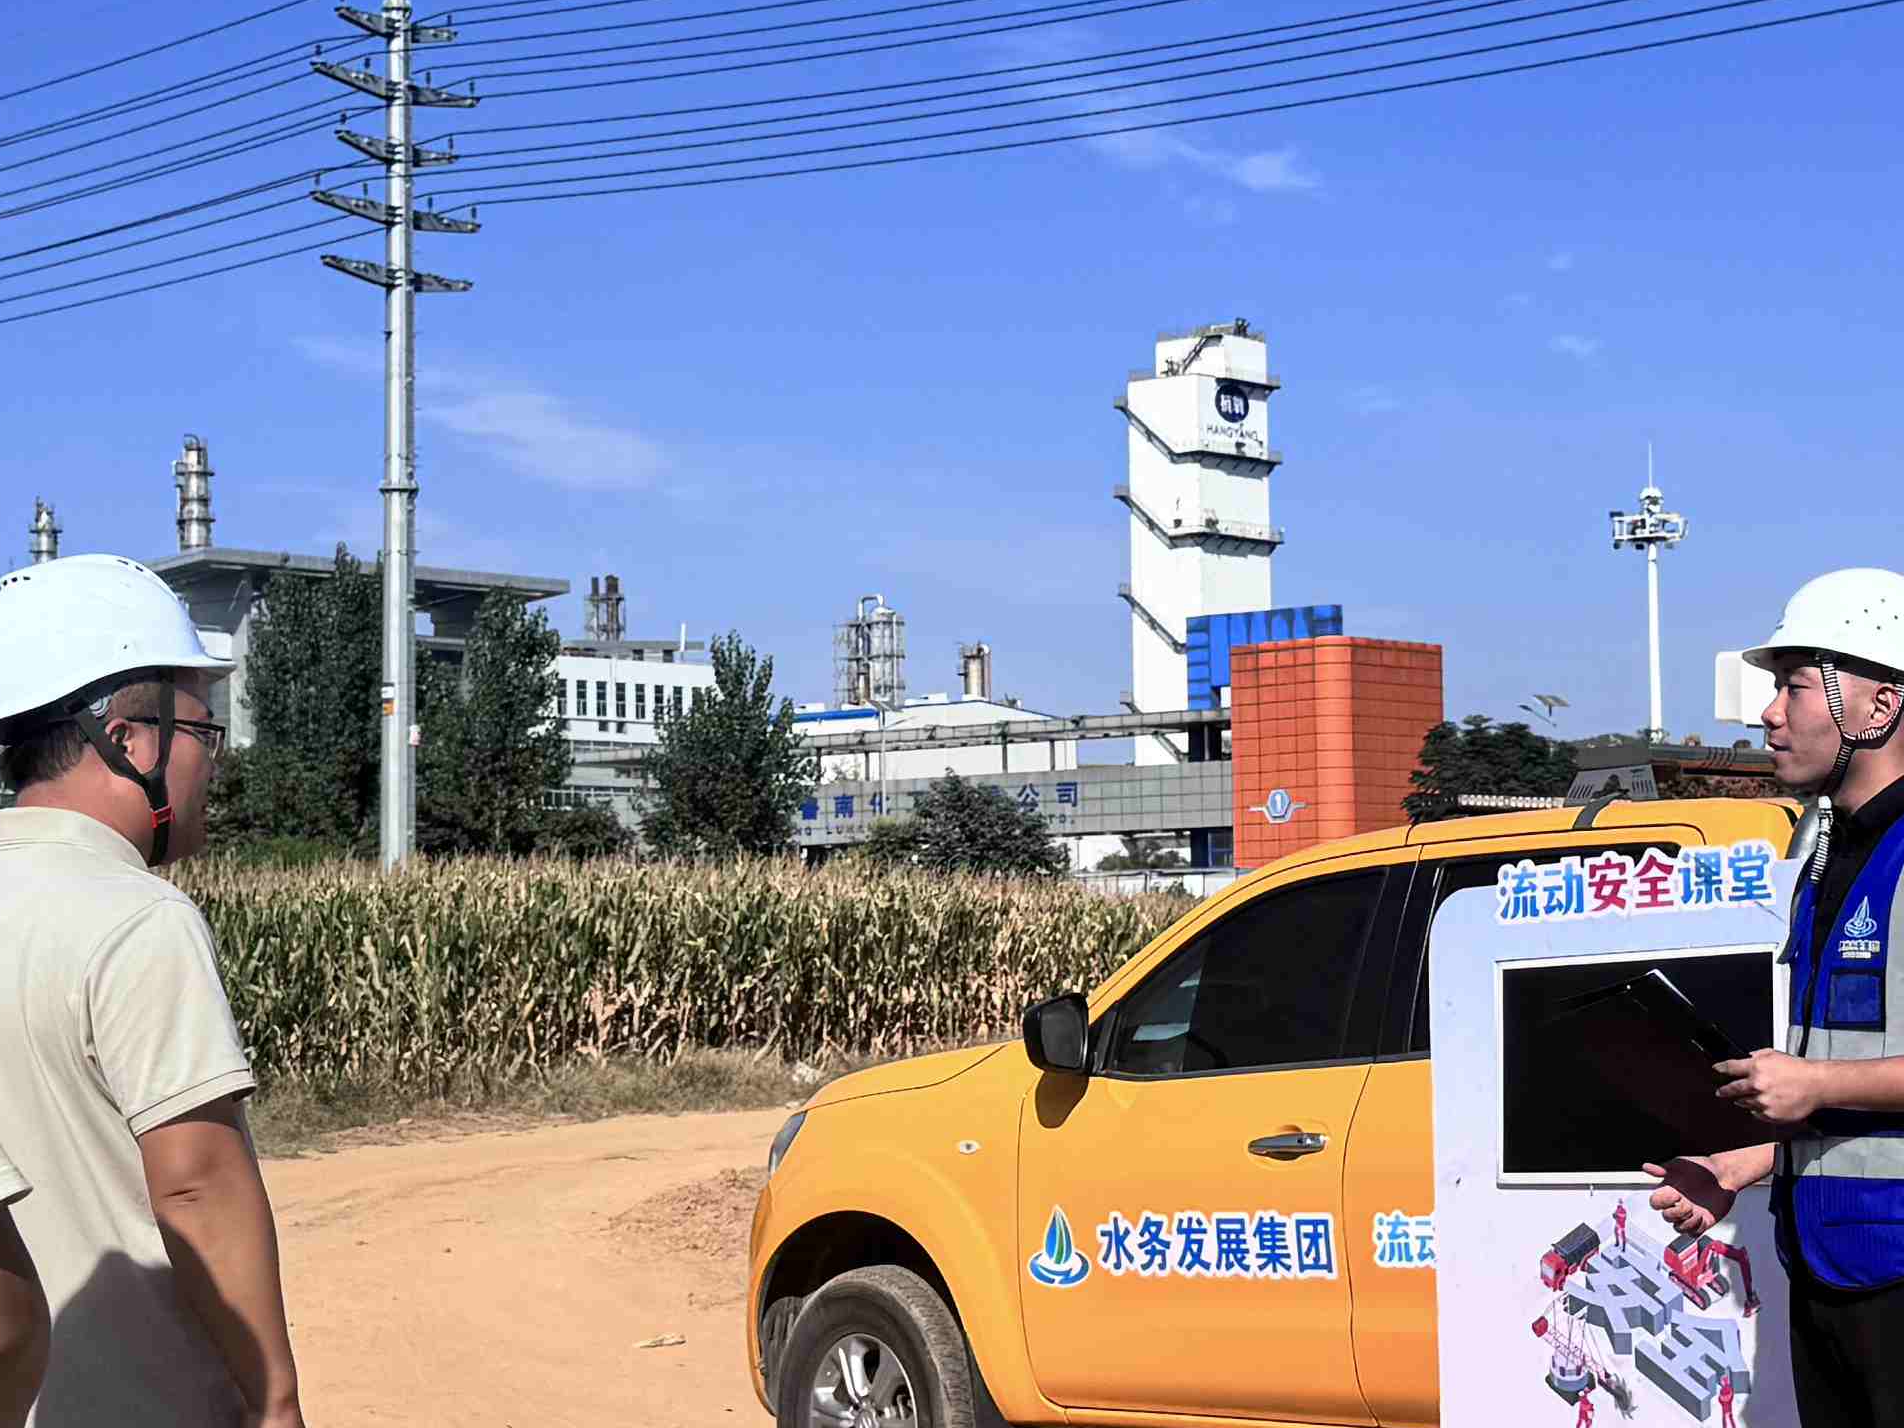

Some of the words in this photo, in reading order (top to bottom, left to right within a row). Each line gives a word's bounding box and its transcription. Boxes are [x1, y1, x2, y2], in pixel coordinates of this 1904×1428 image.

[1207, 424, 1258, 442] HANGYANG
[1499, 844, 1773, 919] 流动安全课堂
[1099, 1215, 1334, 1274] 水务发展集团
